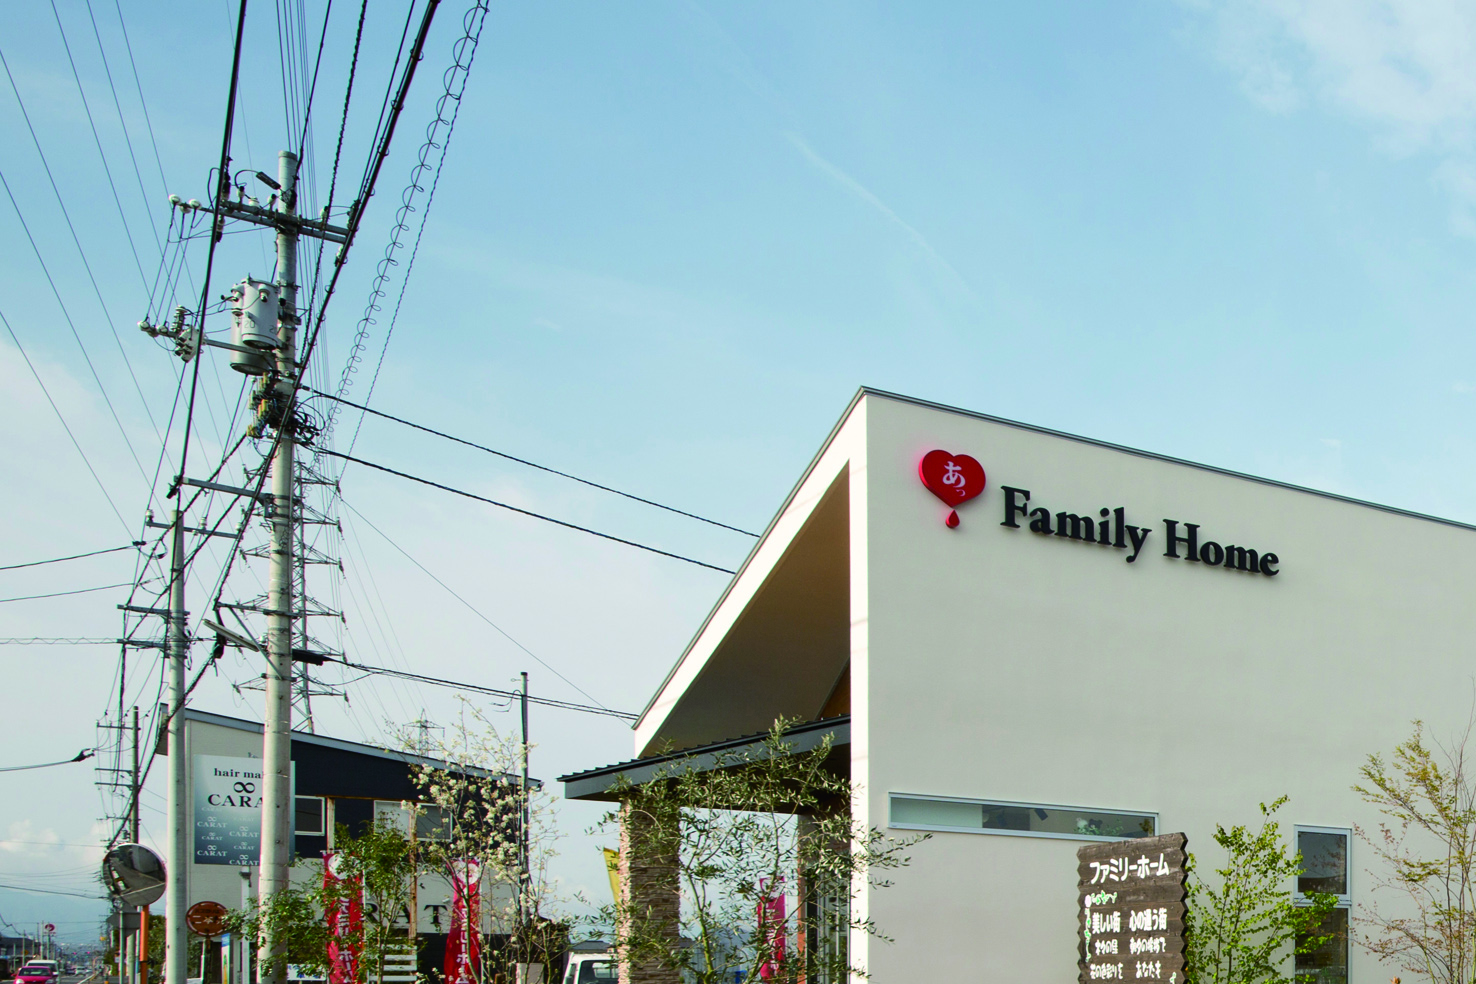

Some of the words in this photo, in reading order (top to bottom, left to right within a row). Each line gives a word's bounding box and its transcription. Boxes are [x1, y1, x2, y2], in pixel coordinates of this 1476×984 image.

[1000, 485, 1151, 564] Family
[1163, 518, 1280, 577] Home
[214, 768, 240, 777] hair
[1089, 853, 1169, 884] ファミリーホーム
[1092, 911, 1121, 934] 美しい街
[1136, 961, 1162, 979] あなたを
